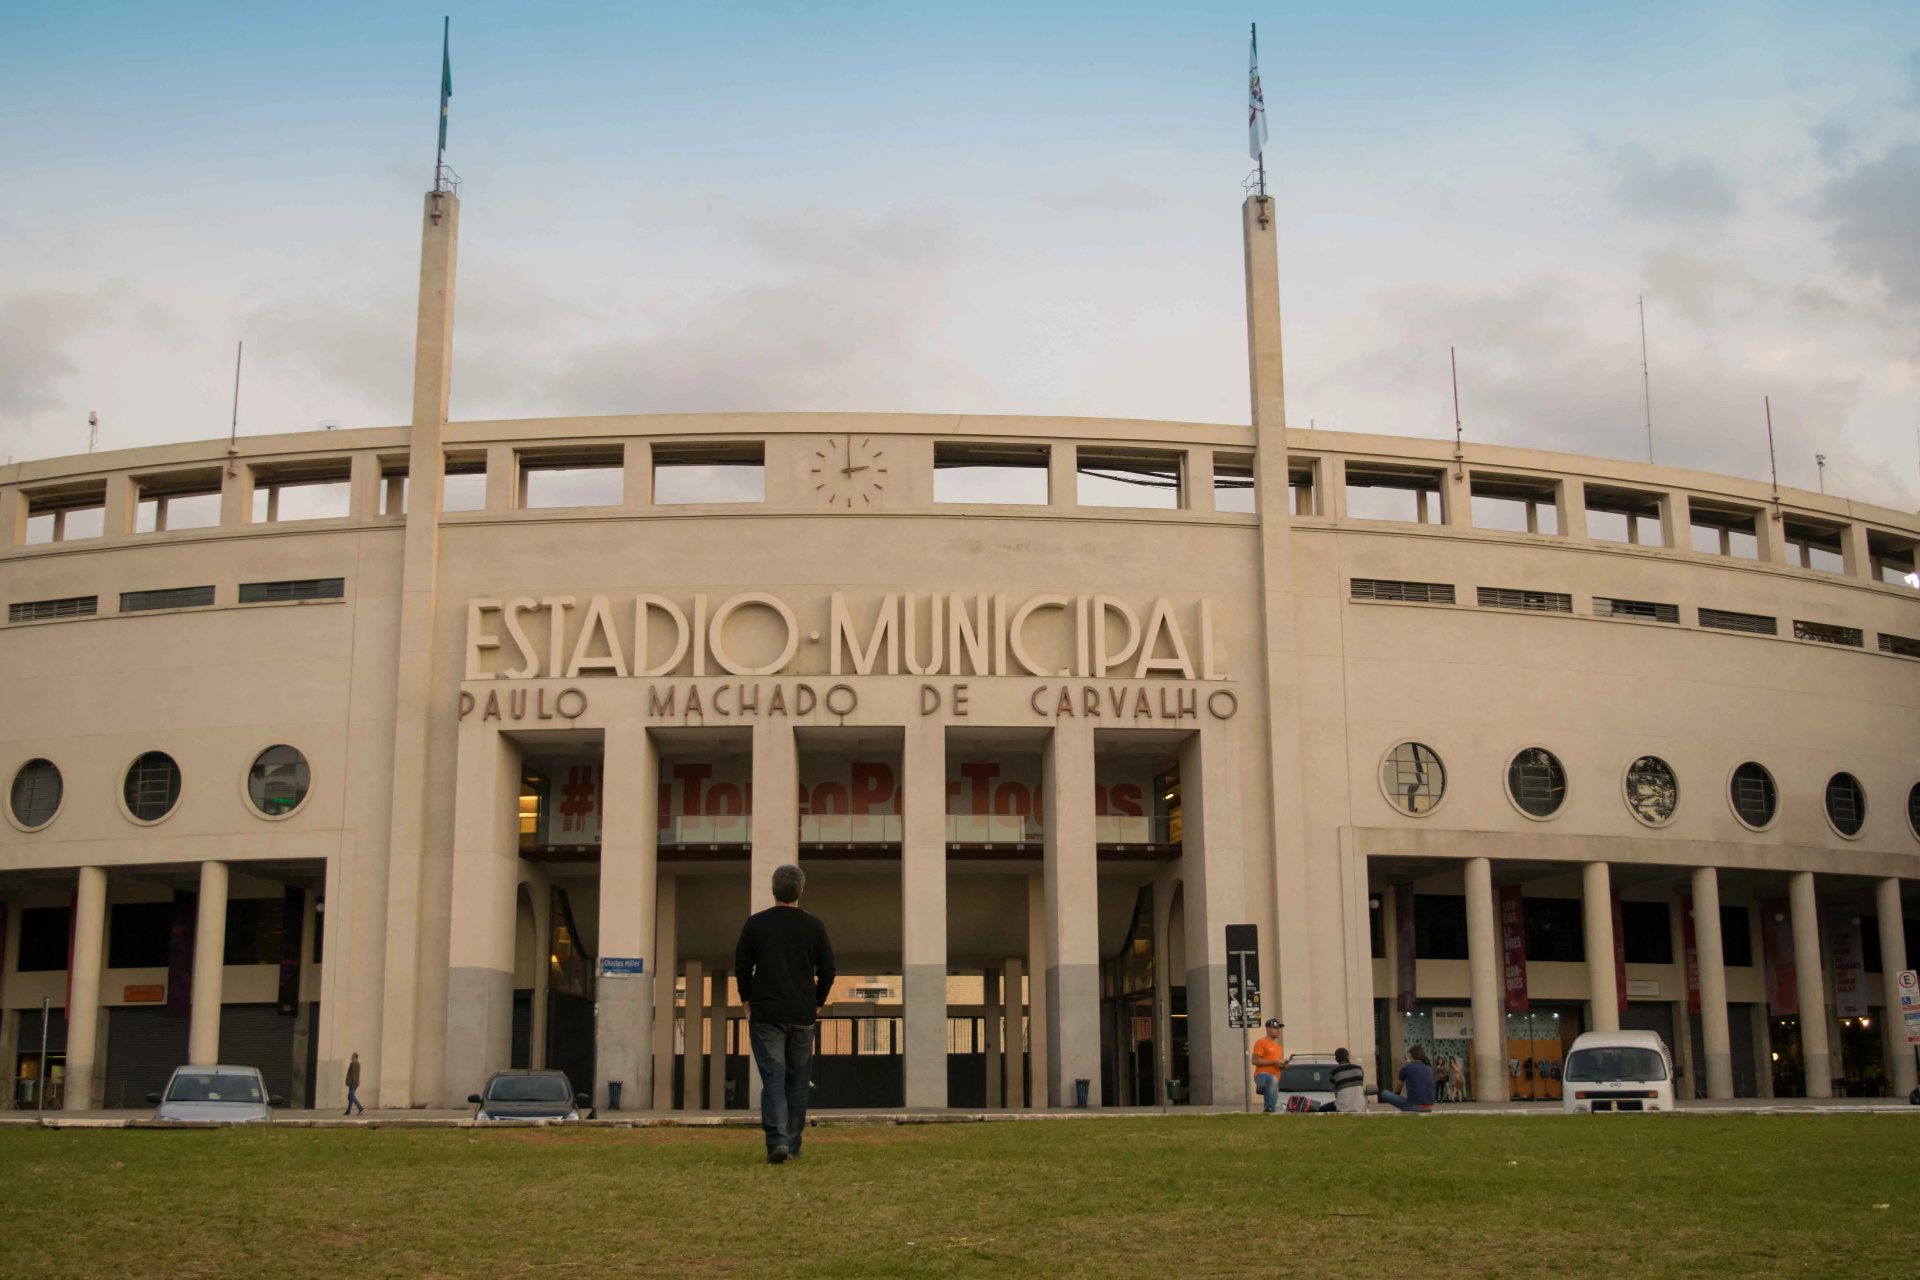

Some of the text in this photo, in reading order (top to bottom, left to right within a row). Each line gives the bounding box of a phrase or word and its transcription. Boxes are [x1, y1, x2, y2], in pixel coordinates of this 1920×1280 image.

[465, 591, 1236, 681] ESTADIO MUNICIPAL
[458, 684, 1238, 721] PAULO MACHADO DE CARVALHO
[604, 959, 641, 967] Charles Miller
[1903, 974, 1911, 986] E
